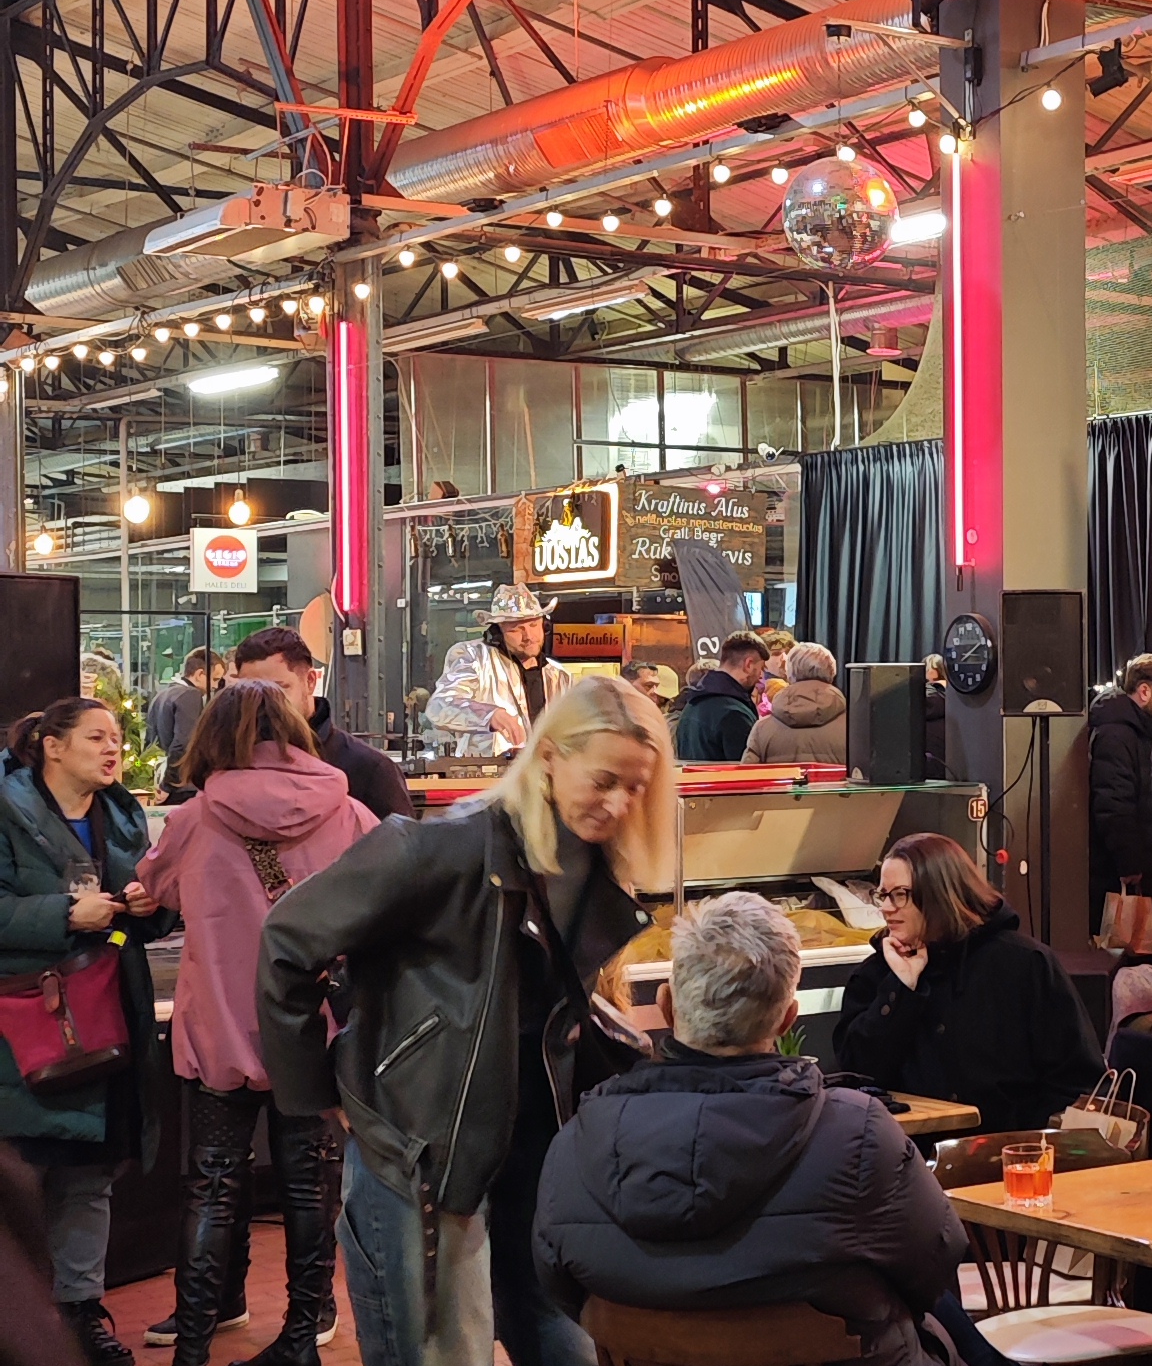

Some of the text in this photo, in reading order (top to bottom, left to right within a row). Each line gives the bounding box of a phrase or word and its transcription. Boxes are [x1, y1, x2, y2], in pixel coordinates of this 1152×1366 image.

[635, 490, 749, 518] Kraftinis Alus
[971, 800, 985, 818] 15
